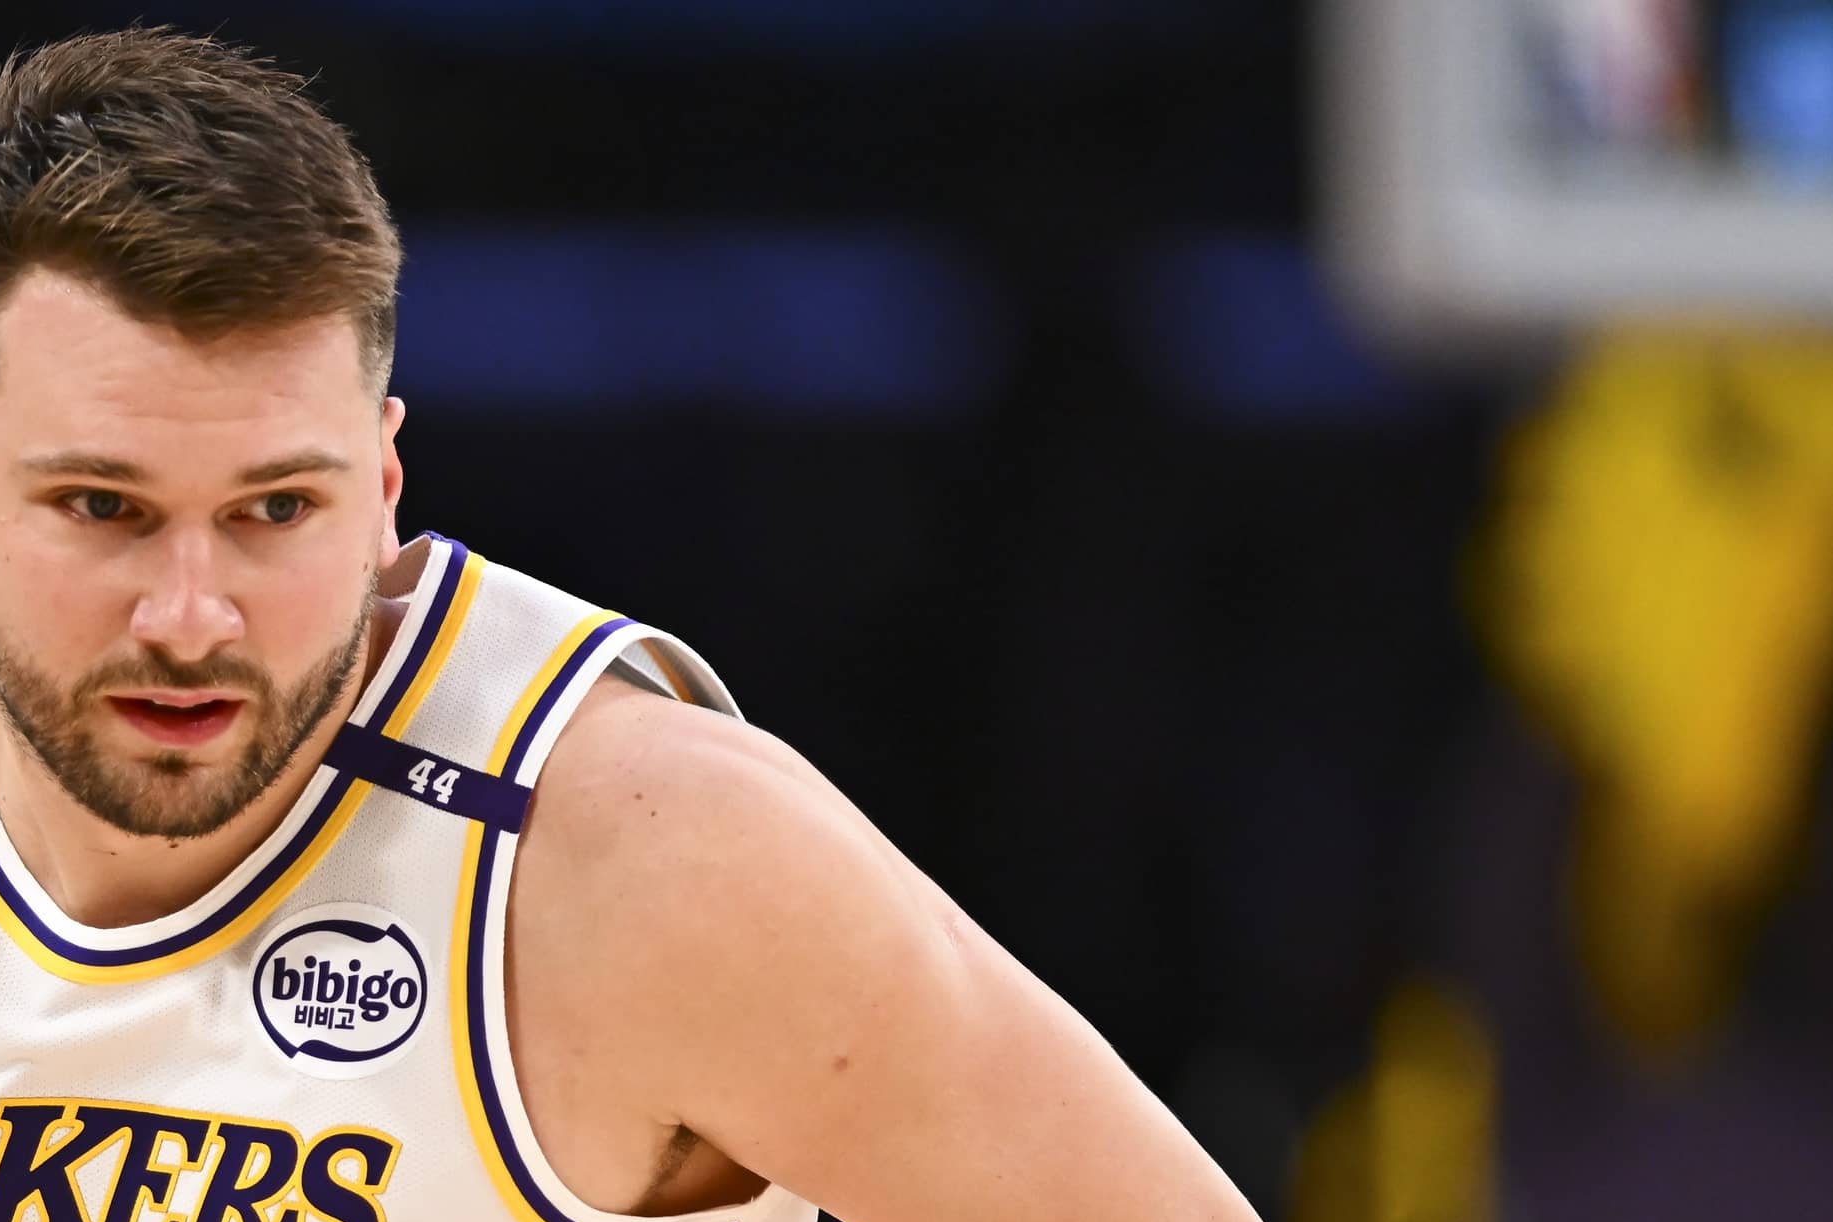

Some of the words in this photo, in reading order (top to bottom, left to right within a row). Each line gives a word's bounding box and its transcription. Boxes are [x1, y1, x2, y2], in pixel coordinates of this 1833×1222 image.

[408, 759, 461, 804] 44
[272, 955, 418, 1022] bibigo
[294, 1004, 355, 1030] 비비고
